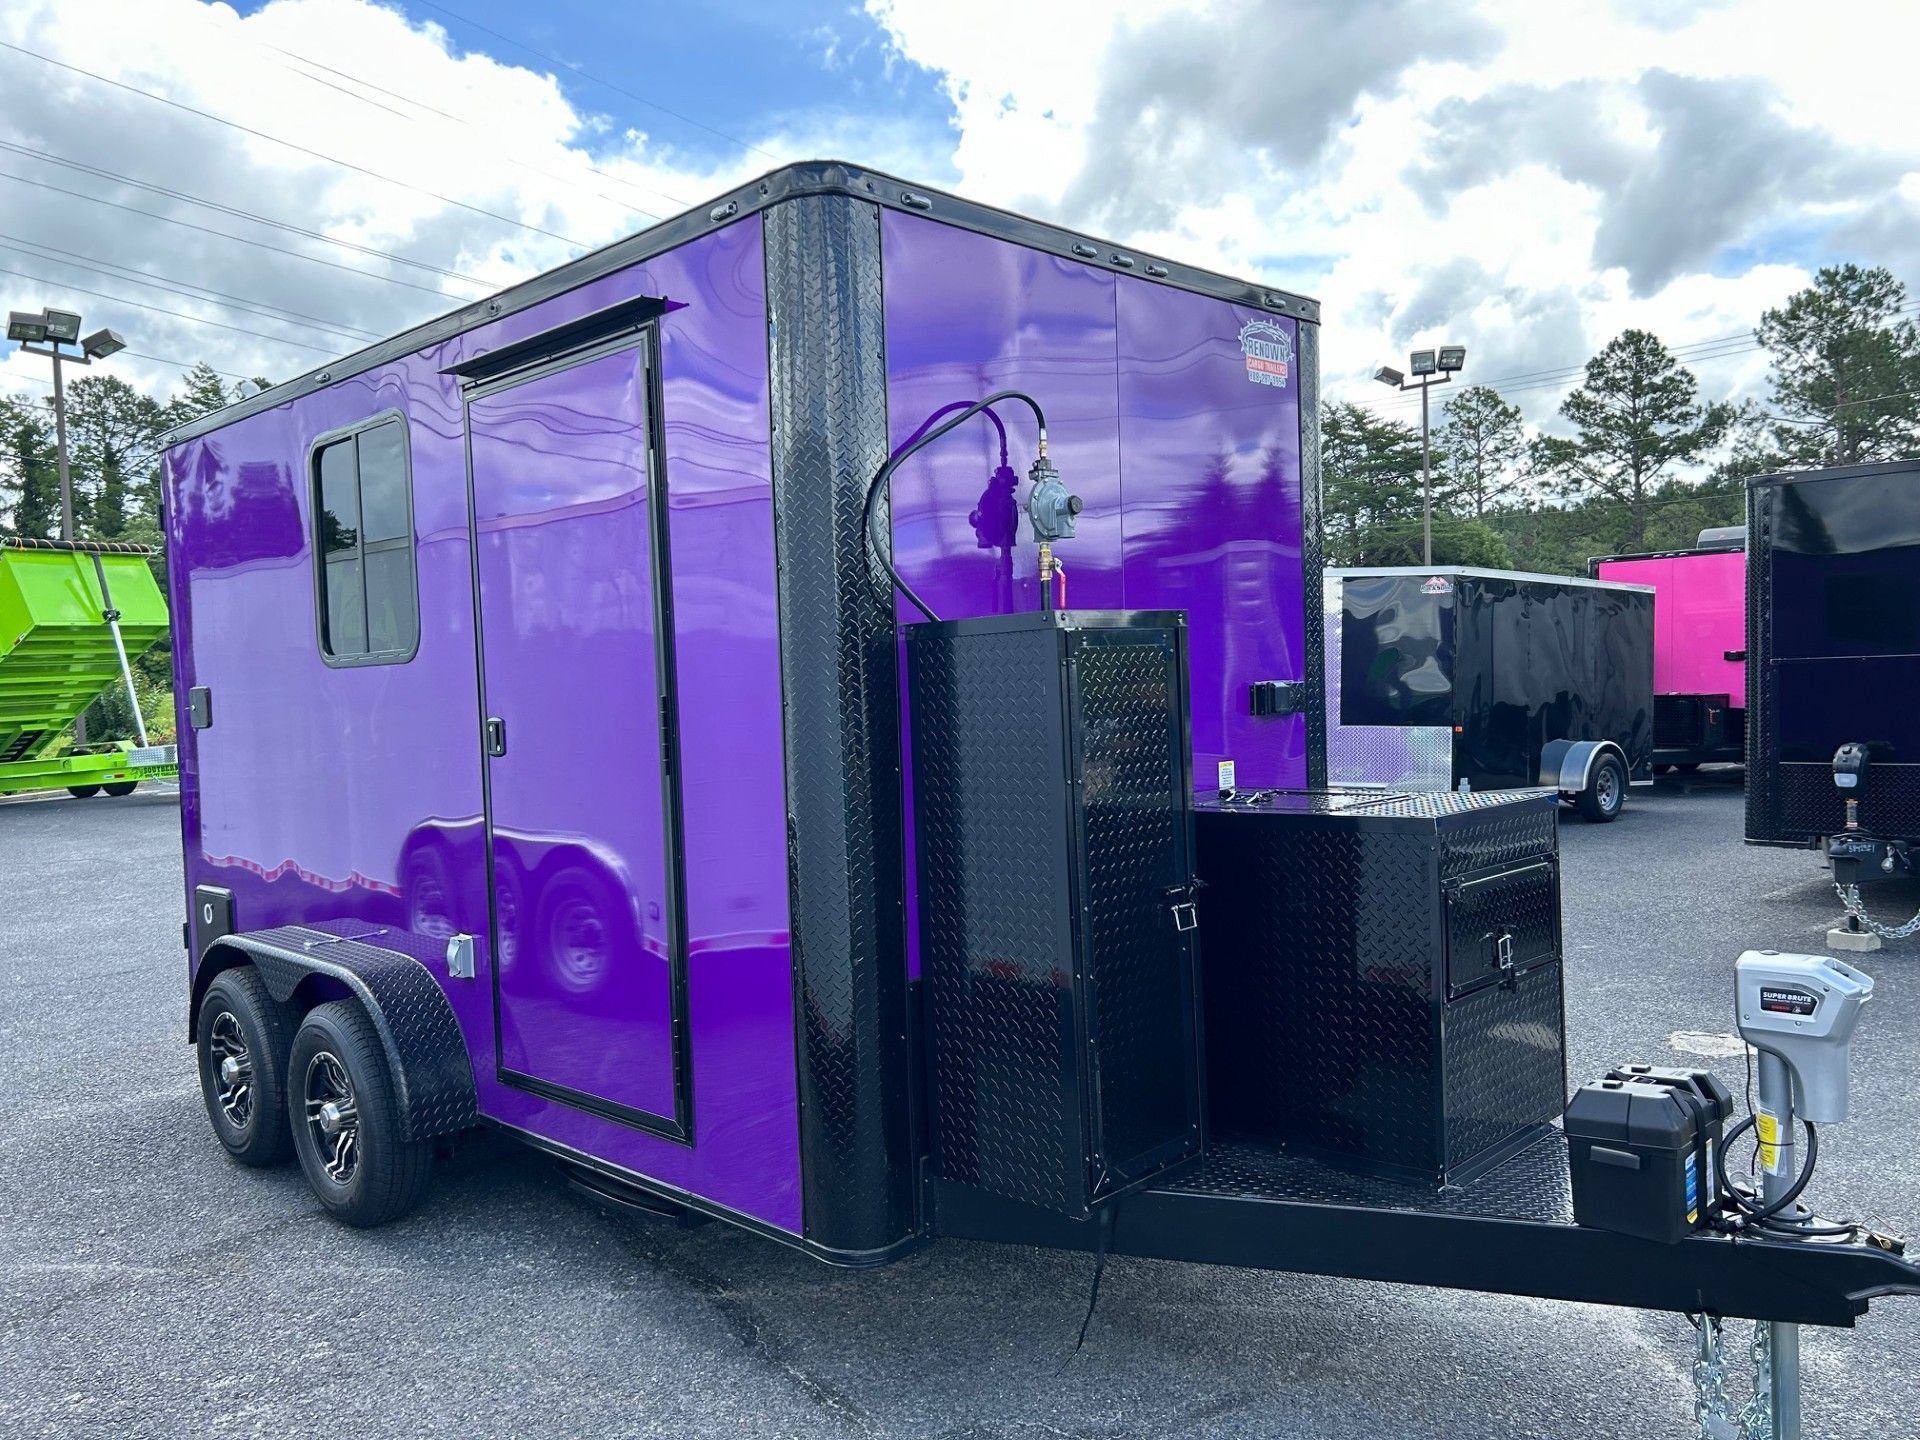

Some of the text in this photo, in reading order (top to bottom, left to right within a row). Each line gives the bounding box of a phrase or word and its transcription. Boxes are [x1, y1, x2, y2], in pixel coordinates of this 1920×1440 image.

[1248, 339, 1286, 362] RENOWN
[1763, 991, 1786, 1000] SUPER
[1787, 994, 1812, 1002] BRUTE
